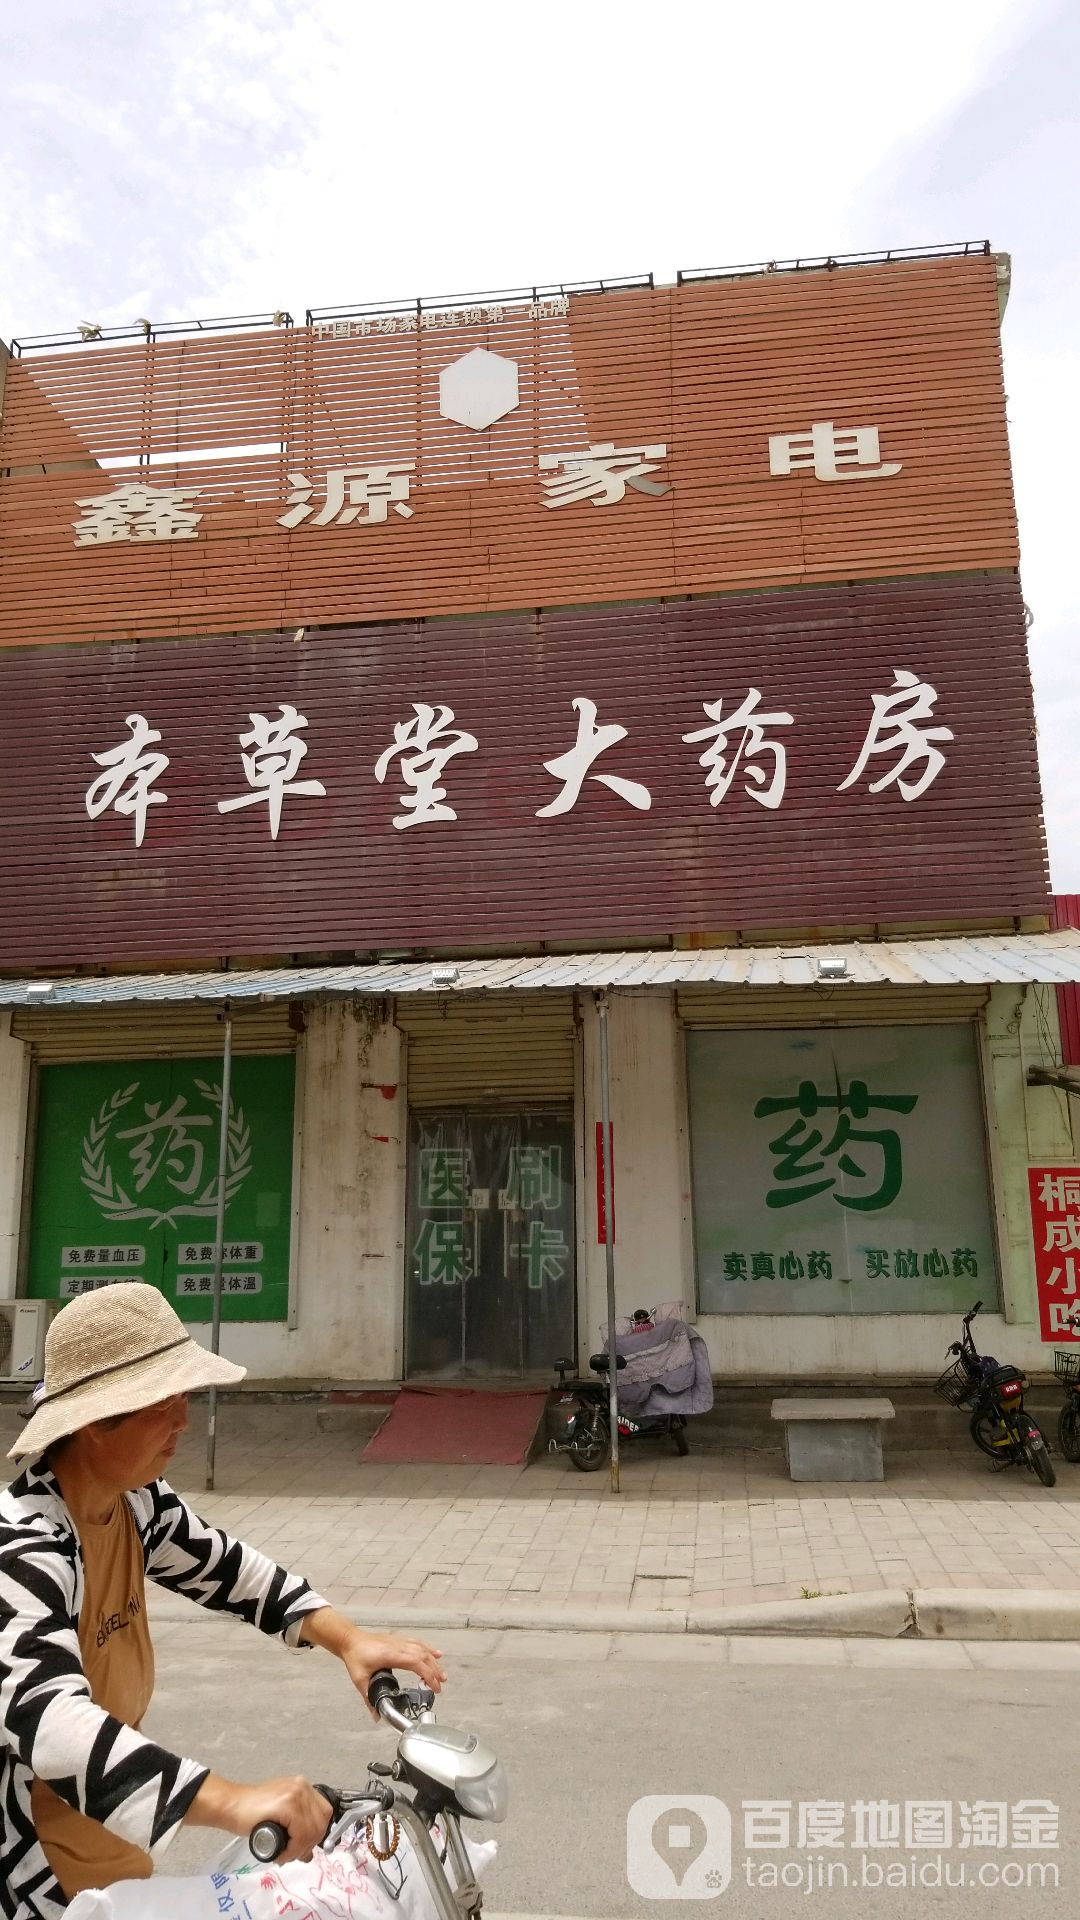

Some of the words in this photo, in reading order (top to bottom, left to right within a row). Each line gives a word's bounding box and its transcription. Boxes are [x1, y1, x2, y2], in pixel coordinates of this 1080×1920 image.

[311, 298, 571, 341] 中国市场家电连锁第一品牌
[71, 421, 903, 548] 鑫源家电
[85, 669, 955, 847] 本草堂大药房
[115, 1094, 213, 1194] 药
[753, 1080, 919, 1211] 药
[68, 1248, 140, 1263] 免费量血压
[723, 1251, 832, 1281] 卖真心药
[865, 1247, 979, 1279] 买放心药
